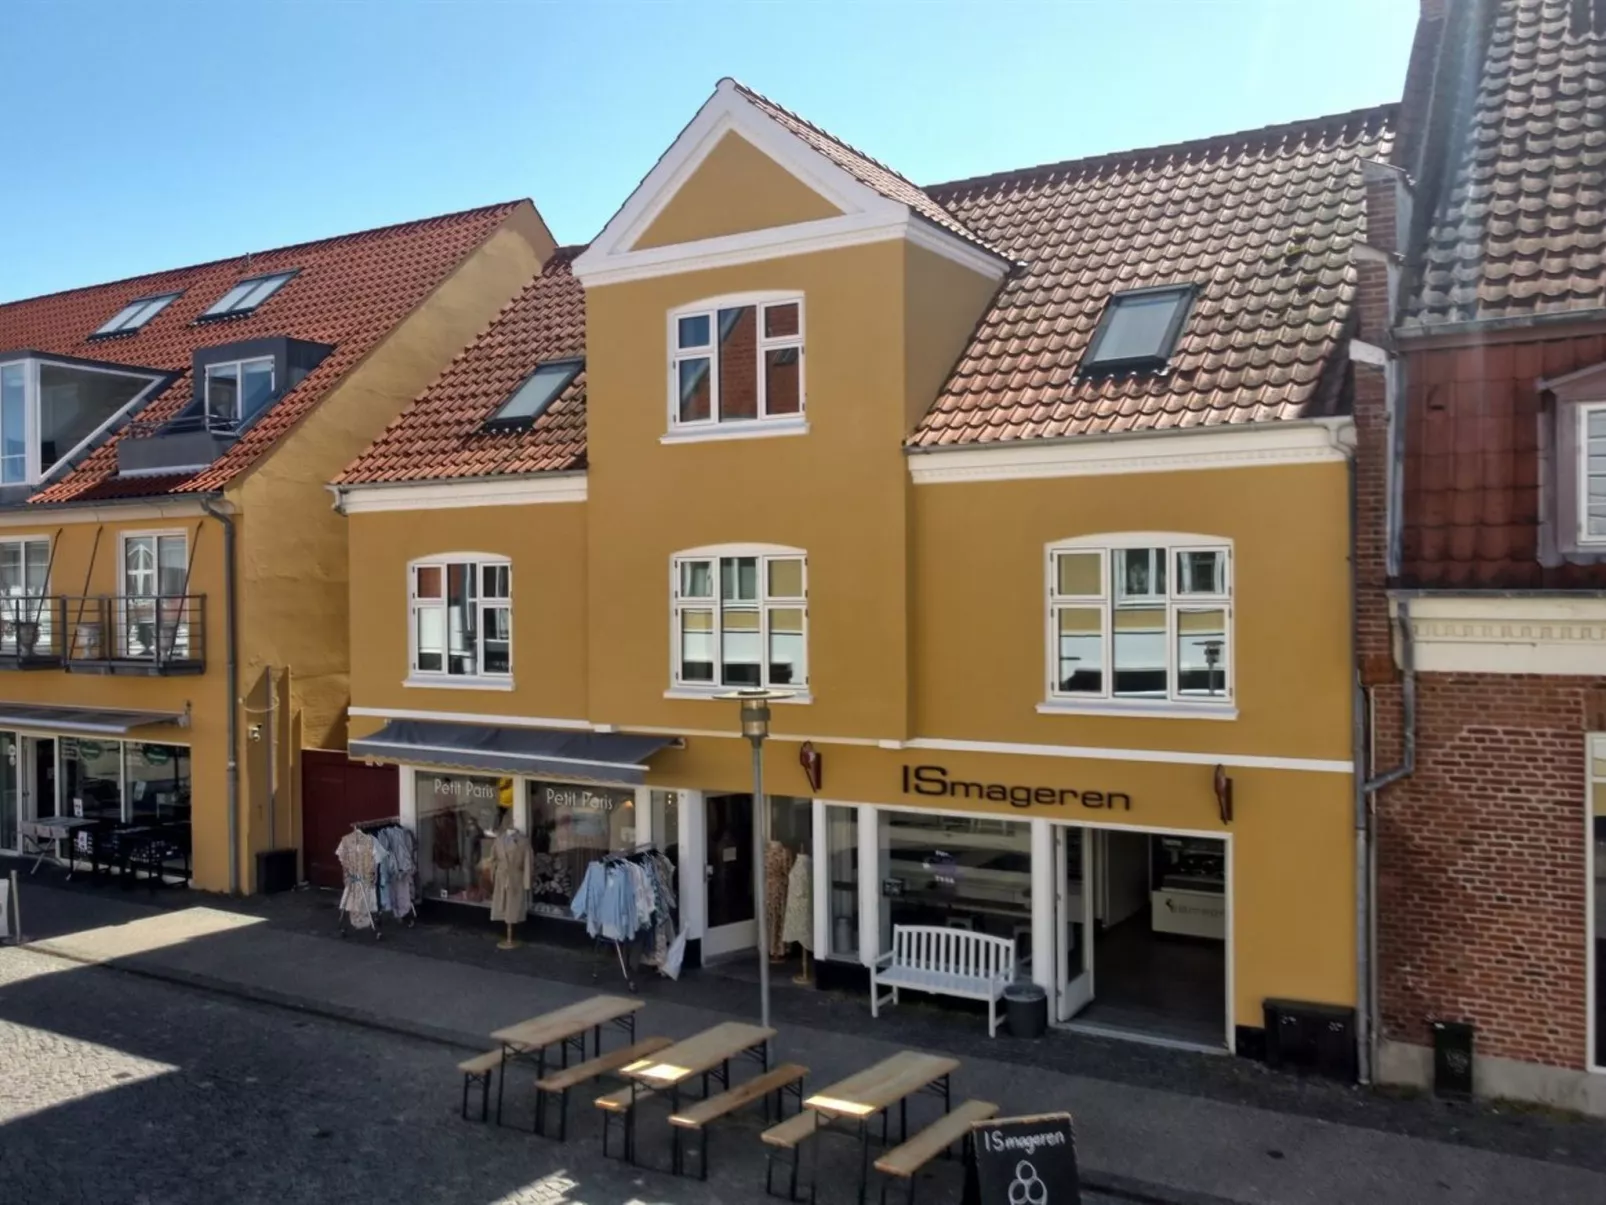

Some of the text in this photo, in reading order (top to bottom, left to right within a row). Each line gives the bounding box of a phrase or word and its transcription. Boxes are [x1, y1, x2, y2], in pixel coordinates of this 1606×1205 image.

[434, 778, 494, 799] Petit Paris
[546, 787, 613, 810] Petit Paris
[902, 764, 1131, 811] ISmageren
